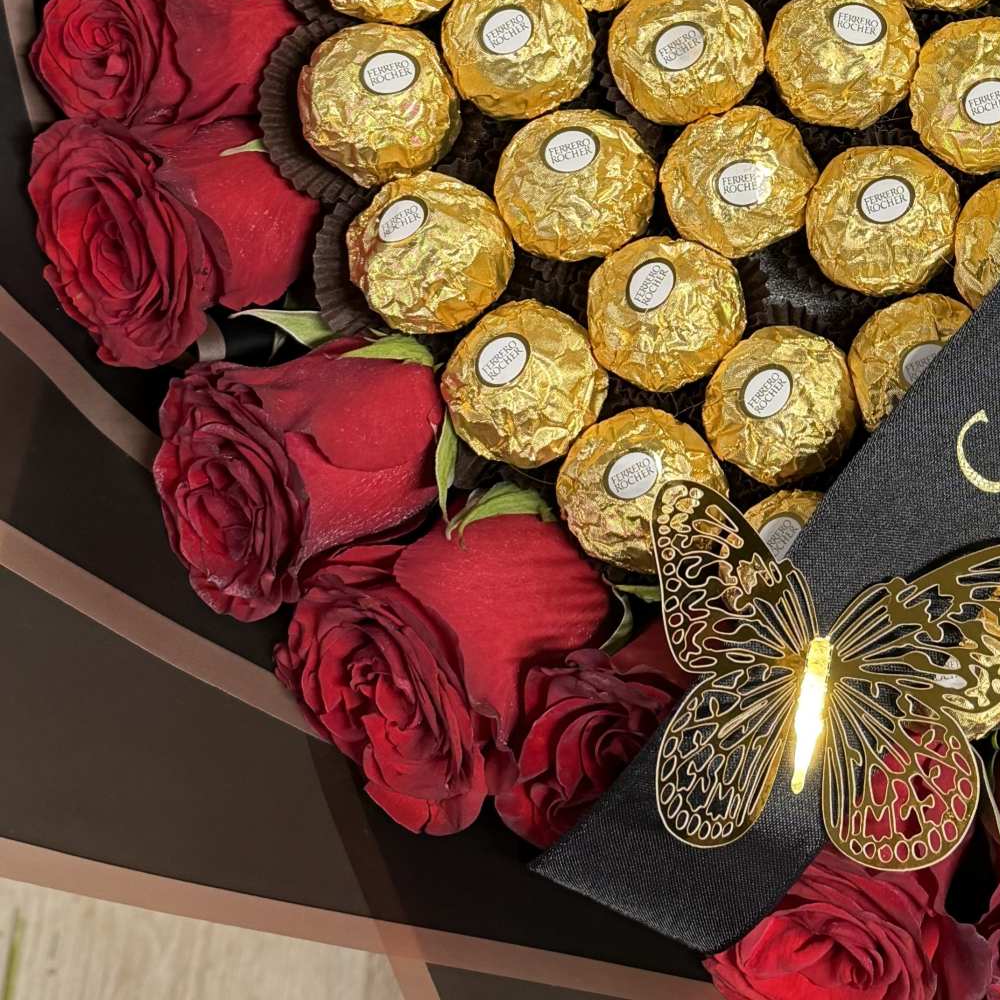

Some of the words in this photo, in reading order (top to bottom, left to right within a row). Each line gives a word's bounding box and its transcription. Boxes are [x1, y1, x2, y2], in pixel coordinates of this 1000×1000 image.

[486, 15, 524, 40] FERRERO
[837, 22, 876, 35] ROCHER
[838, 12, 878, 27] FERRERO
[490, 23, 529, 48] ROCHER
[658, 30, 696, 56] FERRERO
[663, 38, 701, 64] ROCHER
[367, 60, 409, 77] FERRERO
[370, 68, 410, 86] ROCHER
[549, 139, 591, 156] FERRERO
[551, 147, 593, 164] ROCHER
[723, 182, 758, 194] ROCHE
[864, 186, 904, 206] FERRERO
[866, 195, 907, 214] ROCHER
[383, 213, 421, 236] ROCHER
[636, 265, 661, 302] FERRERO
[642, 269, 668, 305] ROCHER
[482, 341, 517, 374] FERRERO
[487, 347, 523, 380] ROCHER
[748, 373, 779, 409] FERRERO
[755, 379, 786, 413] ROCHER
[611, 459, 650, 485] FERRERO
[614, 466, 654, 493] ROCHER
